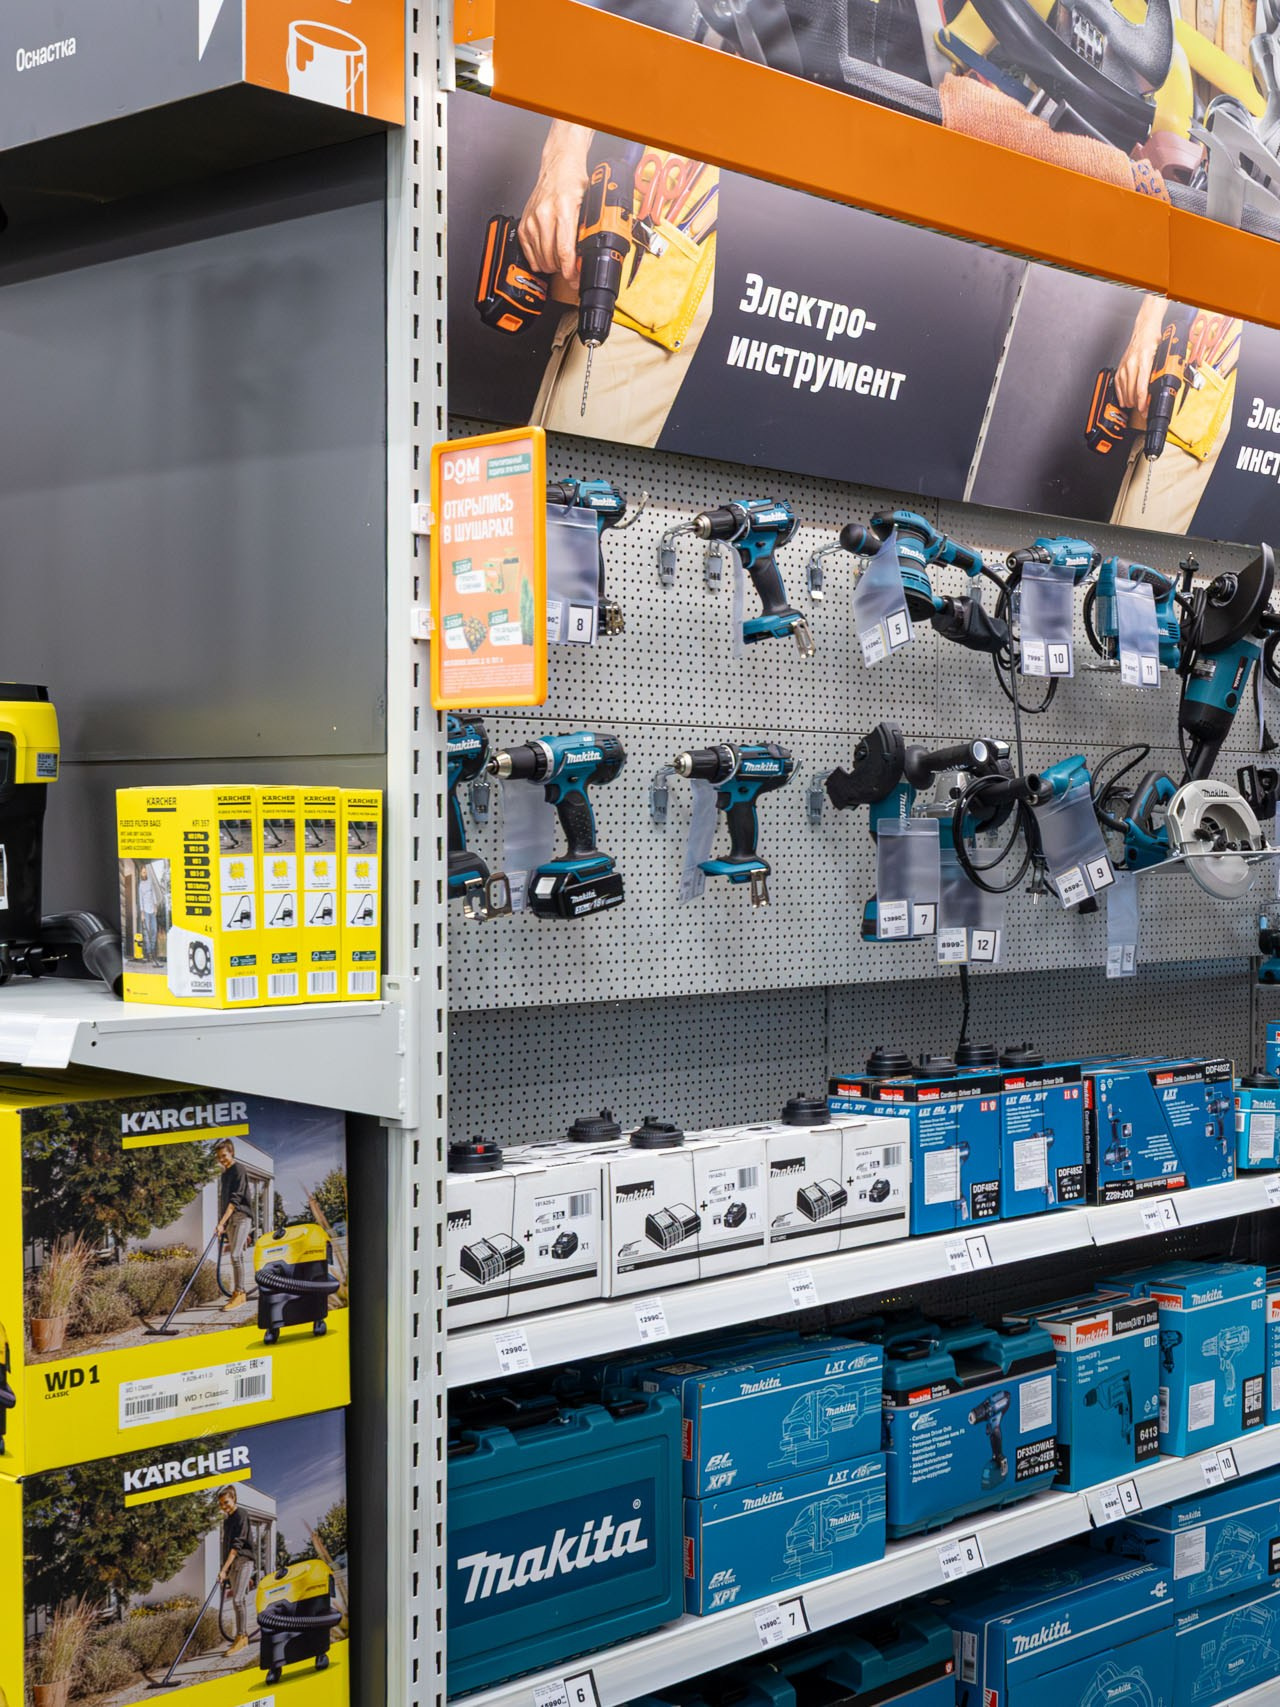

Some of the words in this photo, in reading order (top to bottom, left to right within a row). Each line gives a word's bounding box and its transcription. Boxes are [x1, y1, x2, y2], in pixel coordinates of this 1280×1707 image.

[16, 37, 77, 72] Оснастка
[739, 273, 877, 341] Электро-
[726, 335, 907, 400] инструмент
[444, 456, 480, 483] DOM
[444, 492, 514, 519] ОТКРЫЛИСЬ
[444, 525, 452, 544] В
[454, 516, 514, 543] ШУШАРАХ!
[576, 618, 585, 632] 8
[894, 624, 901, 636] 5
[1054, 653, 1065, 665] 10
[1146, 665, 1153, 676] 11
[1096, 867, 1104, 879] 9
[921, 914, 928, 926] 7
[977, 939, 989, 951] 12
[1205, 1063, 1230, 1075] DDF482Z
[1025, 1080, 1042, 1088] Cordless
[940, 1091, 958, 1099] Cordless
[1163, 1088, 1178, 1101] LXT
[121, 1101, 250, 1134] KÄRCHER
[1057, 1165, 1084, 1178] DDF485Z
[1164, 1208, 1171, 1220] 2
[976, 1246, 982, 1259] 1
[792, 1284, 809, 1292] 12990
[640, 1314, 660, 1324] 12990
[1115, 1315, 1146, 1332] 10mm(3/8")
[1147, 1312, 1157, 1324] Drill
[501, 1345, 523, 1356] 12990
[825, 1360, 847, 1375] LXT
[44, 1367, 86, 1392] WD
[89, 1365, 100, 1385] 1
[44, 1390, 70, 1400] CLASSIC
[184, 1393, 196, 1403] WD
[199, 1391, 203, 1400] 1
[204, 1389, 229, 1399] Classic
[1140, 1426, 1158, 1441] 6413
[1017, 1439, 1055, 1459] DF333DWAE
[705, 1461, 733, 1472] MOTOR
[706, 1452, 733, 1468] BL
[1222, 1457, 1231, 1470] 10
[123, 1445, 250, 1492] KÄRCHER
[705, 1469, 737, 1491] XPT
[828, 1470, 849, 1486] LXT
[1125, 1491, 1131, 1503] 9
[966, 1548, 973, 1561] 8
[708, 1576, 737, 1589] MOTOR
[710, 1568, 735, 1583] BL
[709, 1585, 742, 1608] XPT
[759, 1616, 777, 1631] 13990
[789, 1612, 795, 1626] 7
[577, 1688, 585, 1703] 6
